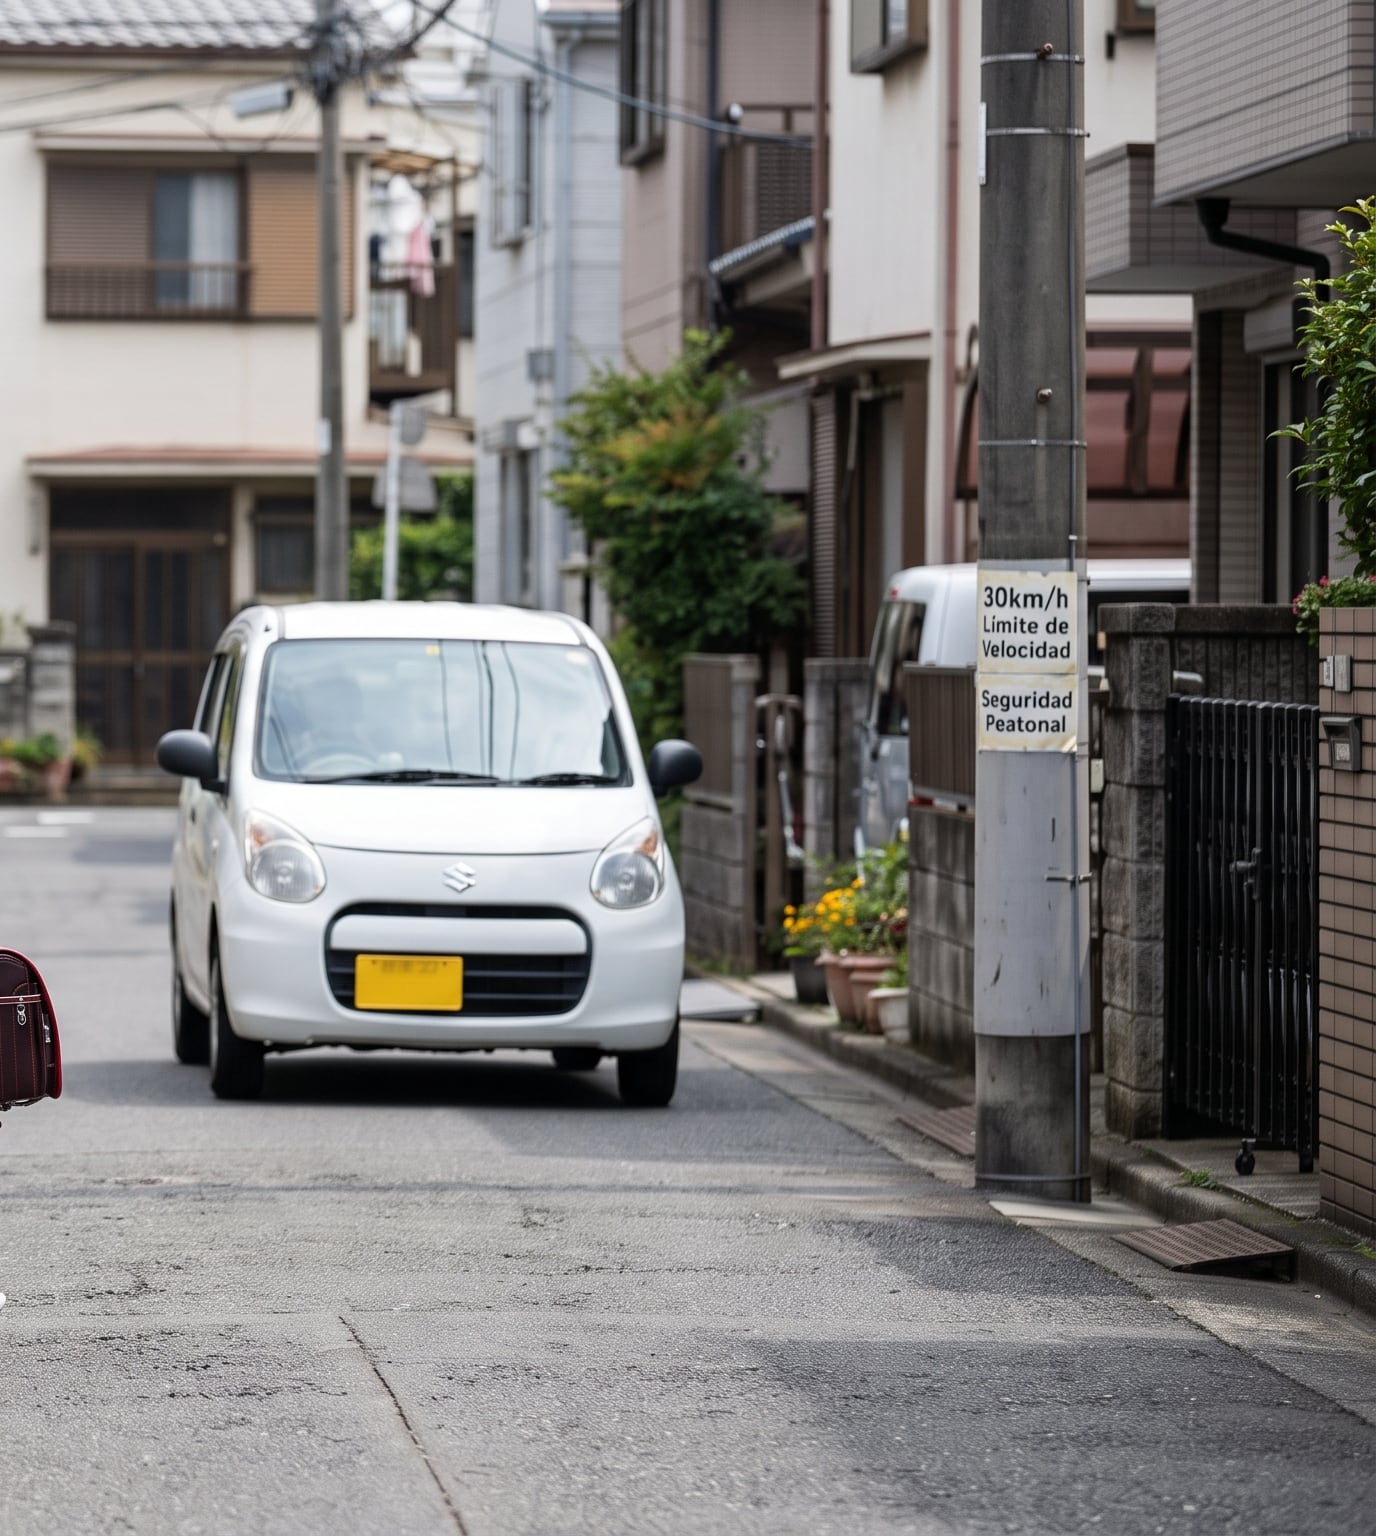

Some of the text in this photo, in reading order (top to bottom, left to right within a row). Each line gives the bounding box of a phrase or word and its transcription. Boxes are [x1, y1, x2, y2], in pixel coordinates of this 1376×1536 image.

[984, 585, 1068, 611] 30km/h
[983, 615, 1069, 634] Límite de
[982, 640, 1070, 659] Velocidad
[982, 689, 1072, 712] Seguridad
[986, 714, 1066, 733] Peatonal
